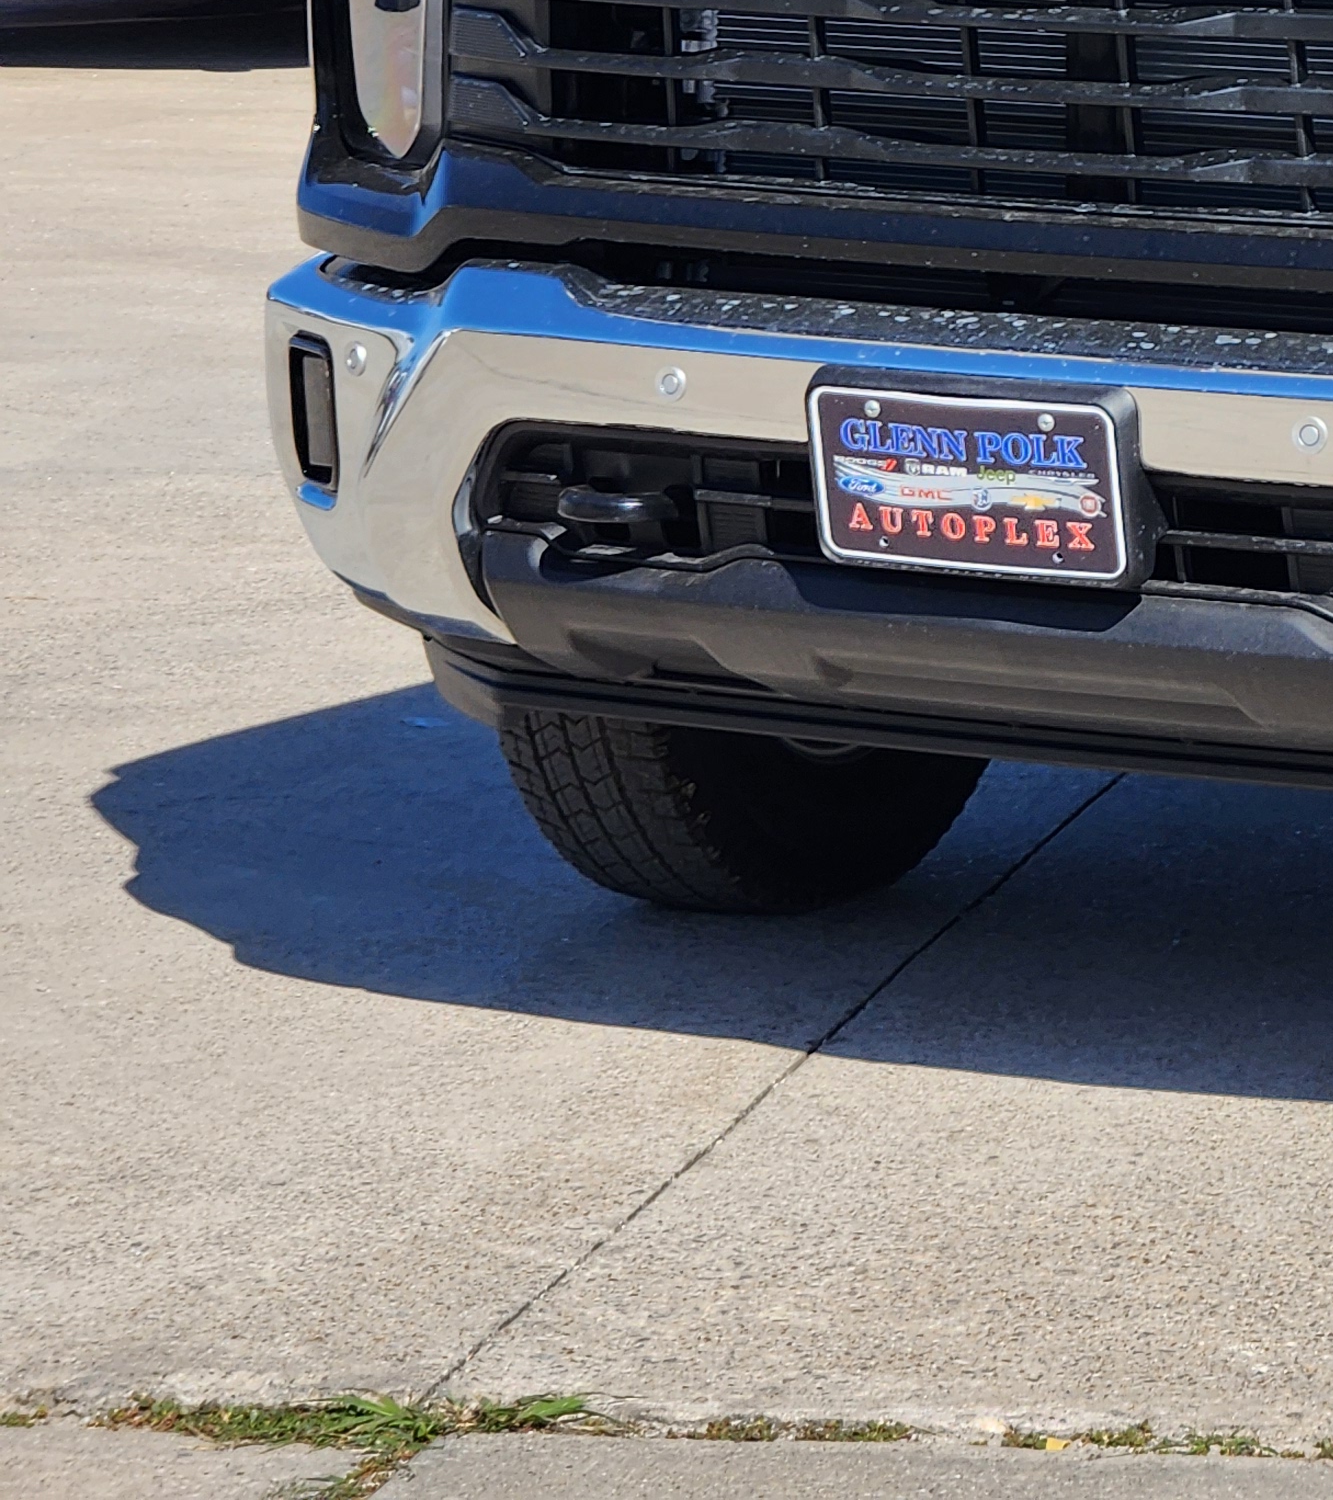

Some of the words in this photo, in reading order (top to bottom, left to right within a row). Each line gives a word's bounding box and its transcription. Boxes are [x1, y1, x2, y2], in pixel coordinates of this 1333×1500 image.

[840, 417, 968, 462] GLENN
[975, 431, 1087, 469] POLK
[922, 463, 968, 477] RAM
[977, 465, 1016, 485] Jeep
[1028, 469, 1096, 479] CHRYSLER
[848, 479, 877, 493] Ford
[901, 485, 953, 501] GMC
[849, 502, 1096, 550] AUTOPLEX
